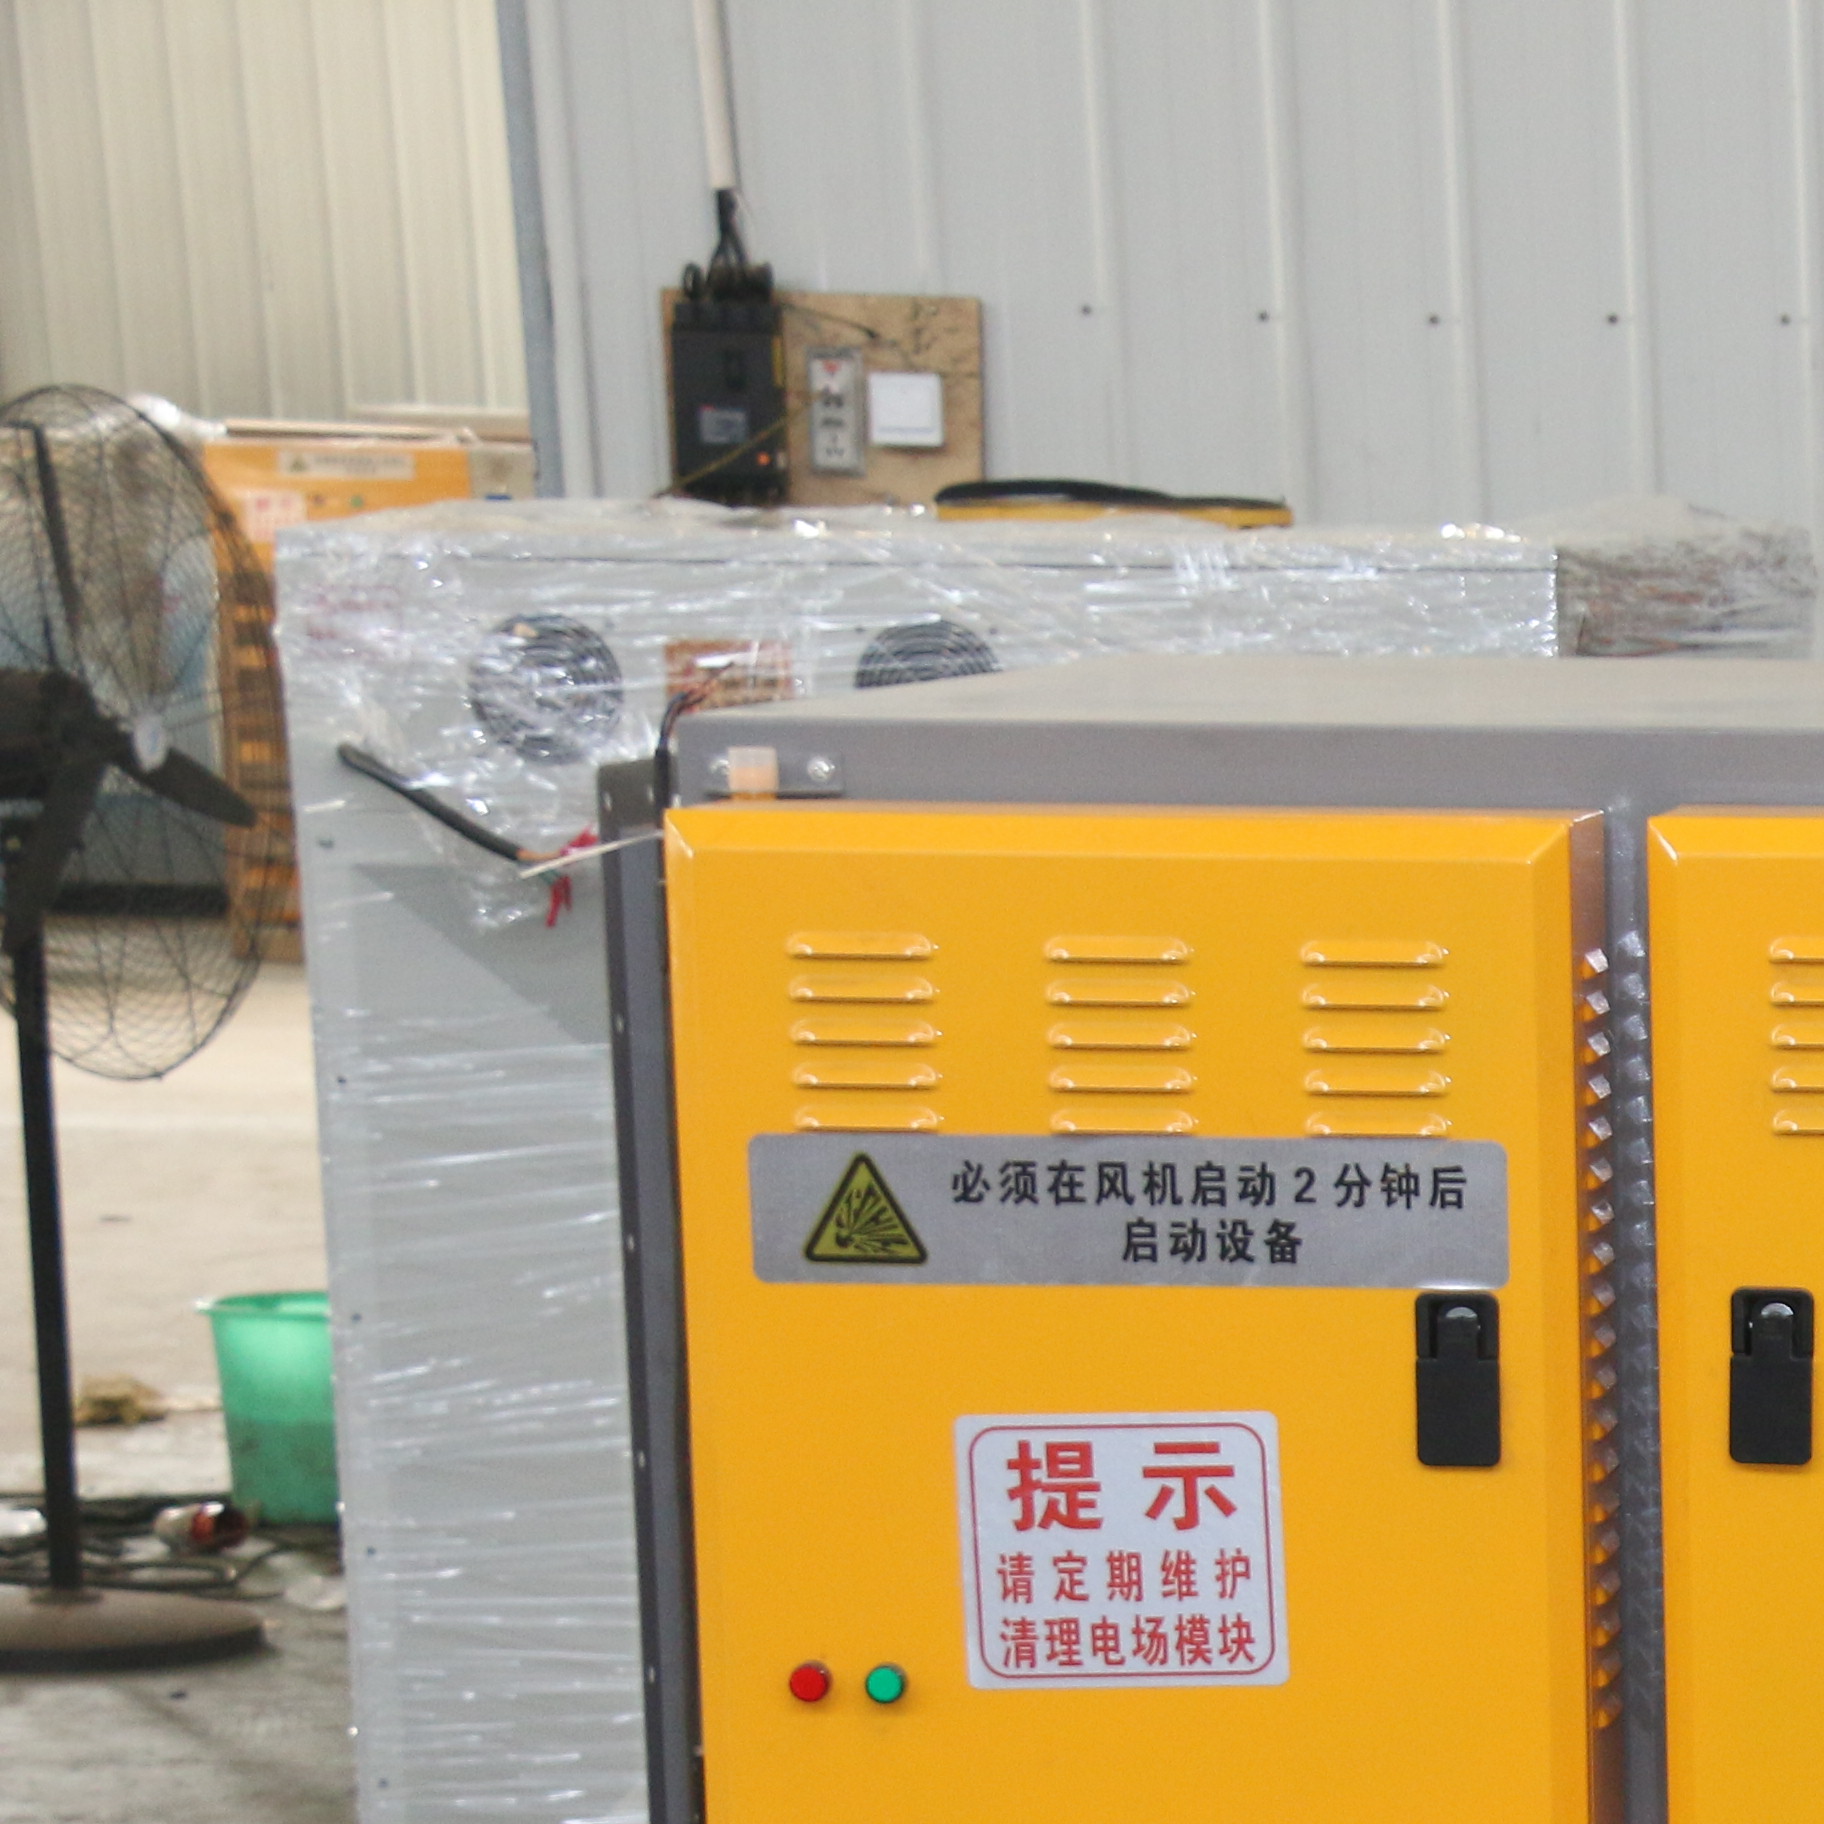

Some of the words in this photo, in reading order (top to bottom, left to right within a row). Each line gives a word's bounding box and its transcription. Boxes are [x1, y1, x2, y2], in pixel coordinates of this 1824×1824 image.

[952, 1159, 1467, 1210] 必须在风机启动2分钟后
[1122, 1217, 1303, 1265] 启动设备
[1007, 1441, 1237, 1531] 提示
[998, 1551, 1253, 1603] 请定期维护
[1000, 1614, 1257, 1669] 清理电场模块
